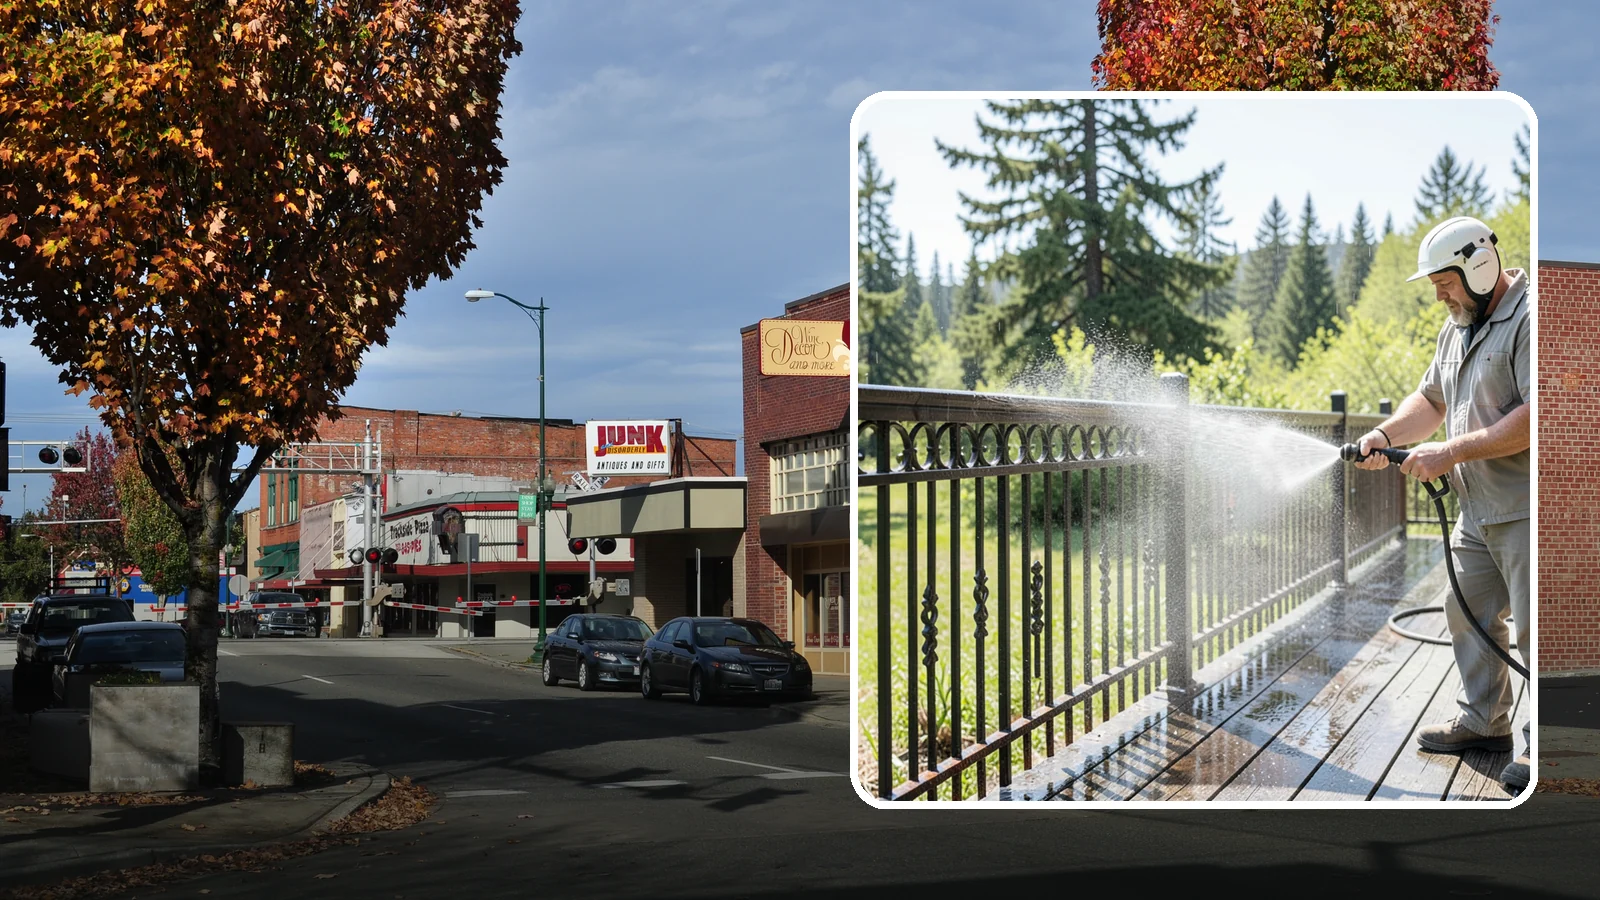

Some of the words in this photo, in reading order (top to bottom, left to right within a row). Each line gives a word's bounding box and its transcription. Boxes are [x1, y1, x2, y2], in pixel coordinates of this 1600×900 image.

[765, 327, 830, 365] Decor
[595, 425, 665, 457] JUNK
[607, 446, 646, 454] DISORDERLY
[597, 461, 628, 470] ANTIQUES
[631, 461, 644, 470] AND
[647, 460, 665, 469] GIFTS
[414, 519, 429, 535] Pizza
